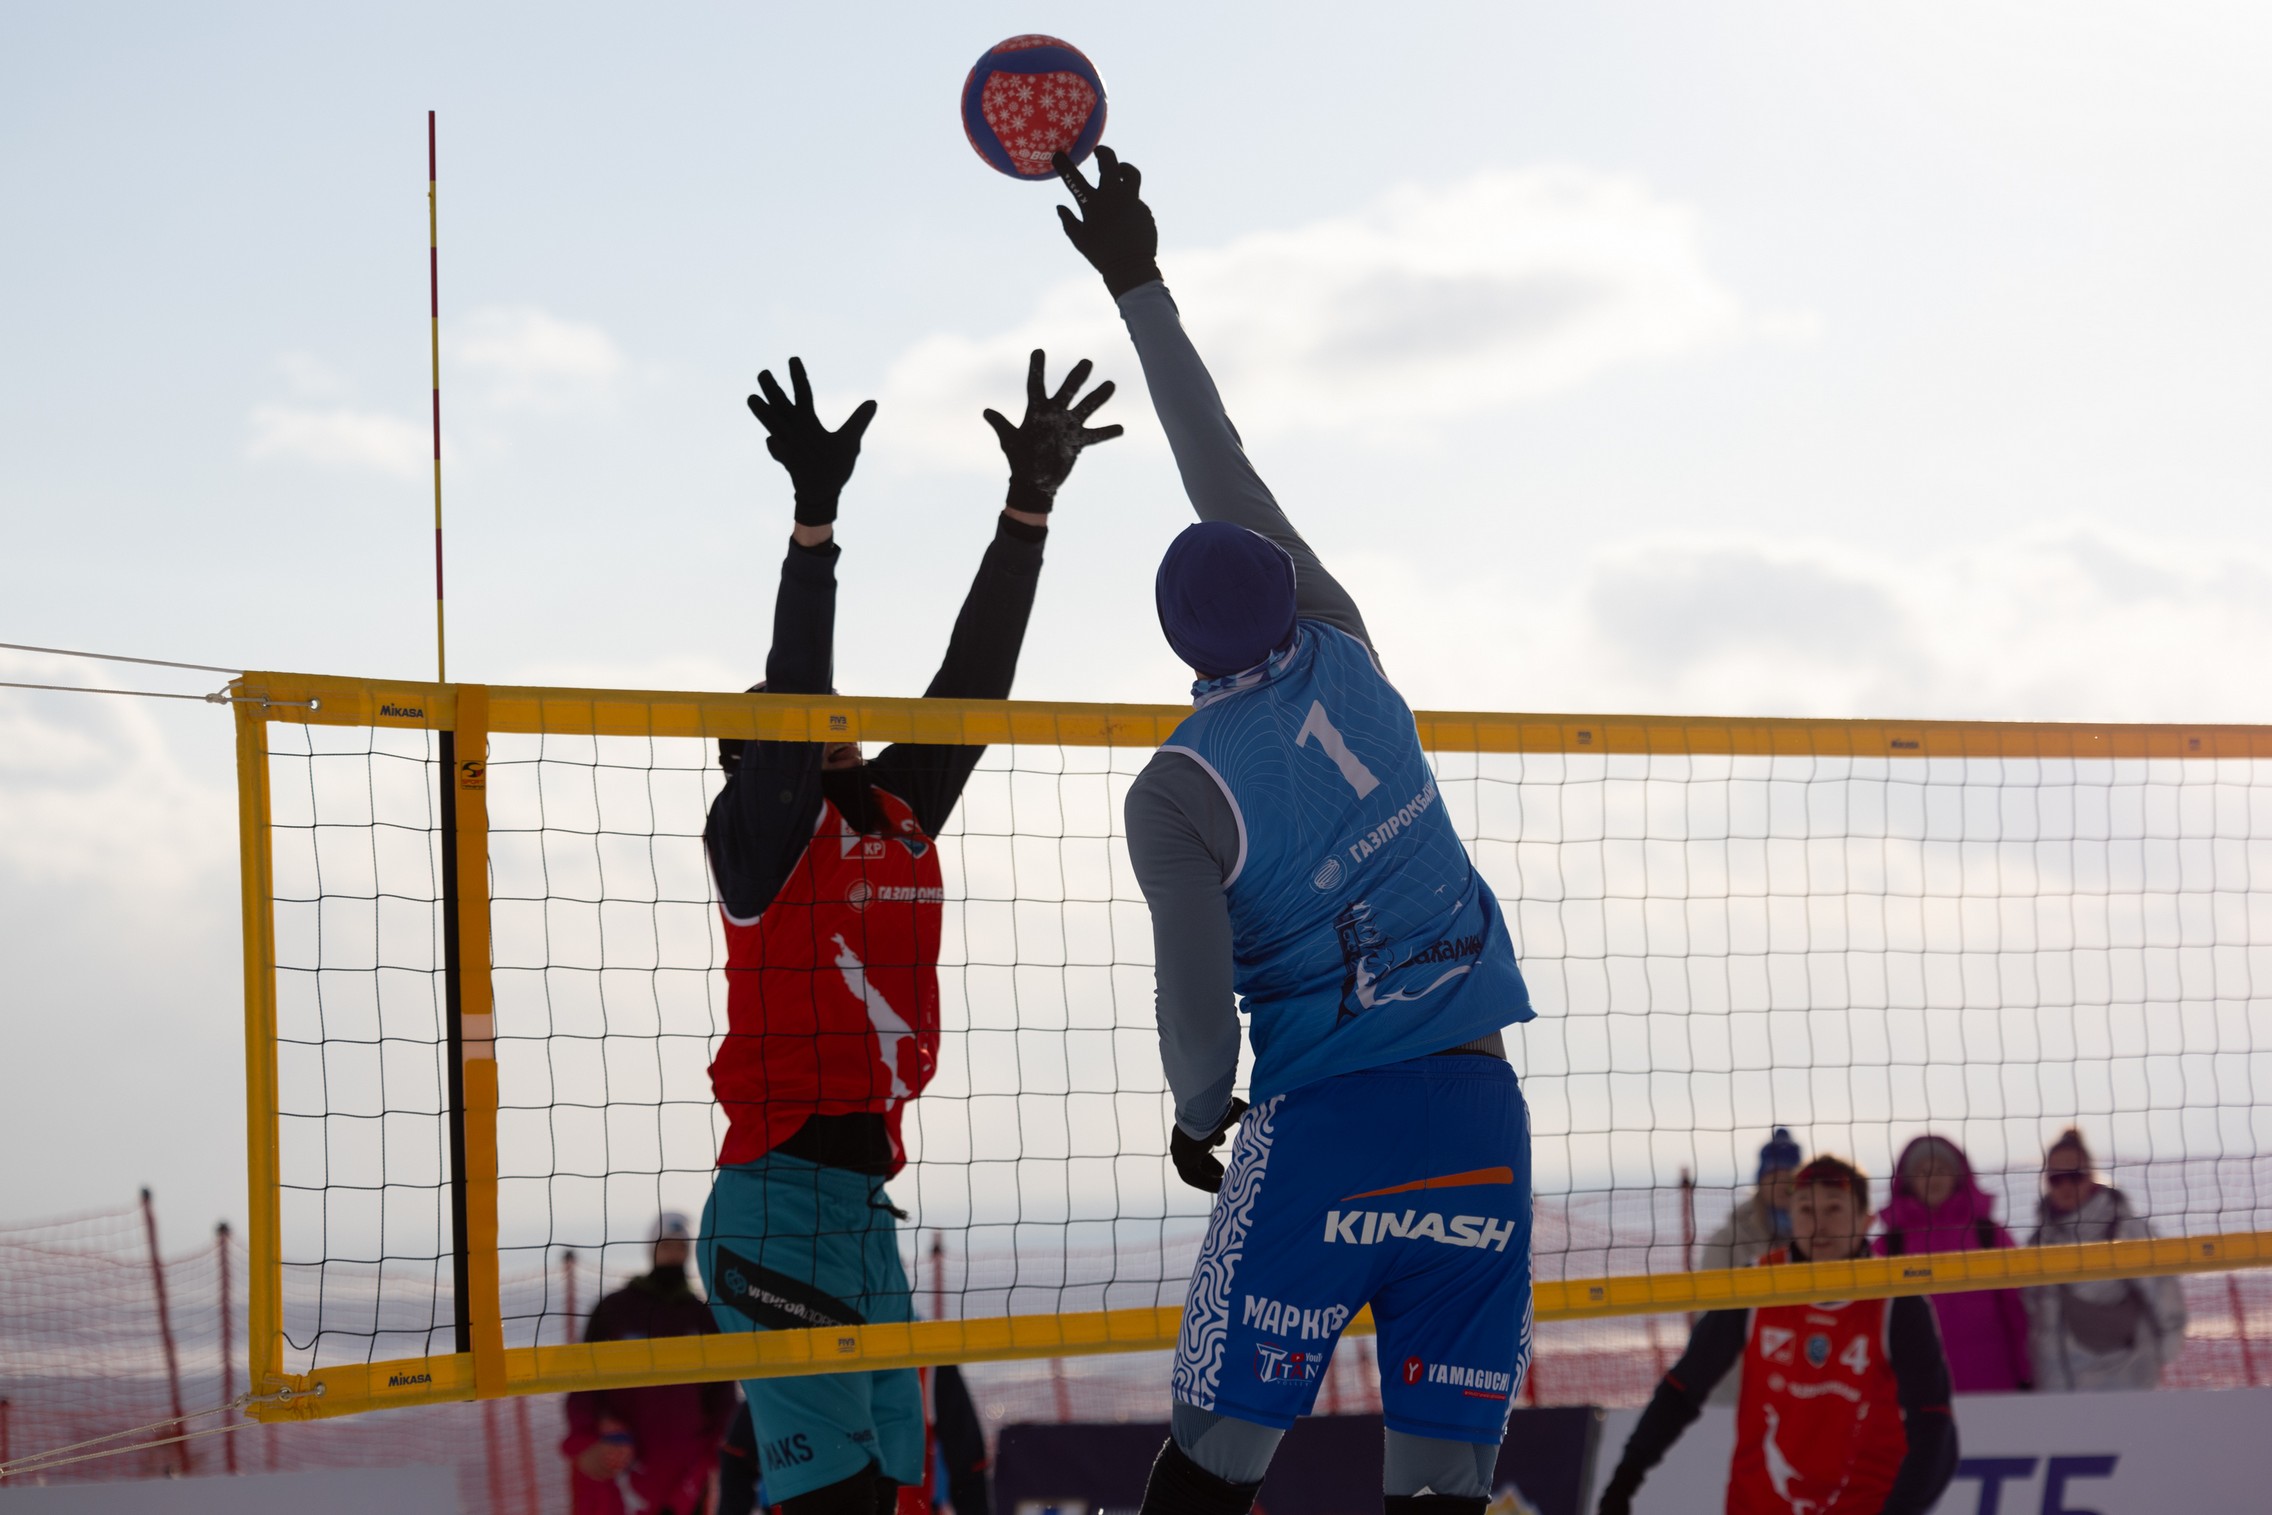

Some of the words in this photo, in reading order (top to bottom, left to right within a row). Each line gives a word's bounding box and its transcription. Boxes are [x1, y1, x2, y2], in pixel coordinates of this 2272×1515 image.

[1065, 173, 1088, 204] KIPSTA
[1296, 699, 1380, 800] 1
[1323, 1209, 1516, 1252] KINASH
[1839, 1333, 1870, 1376] 4
